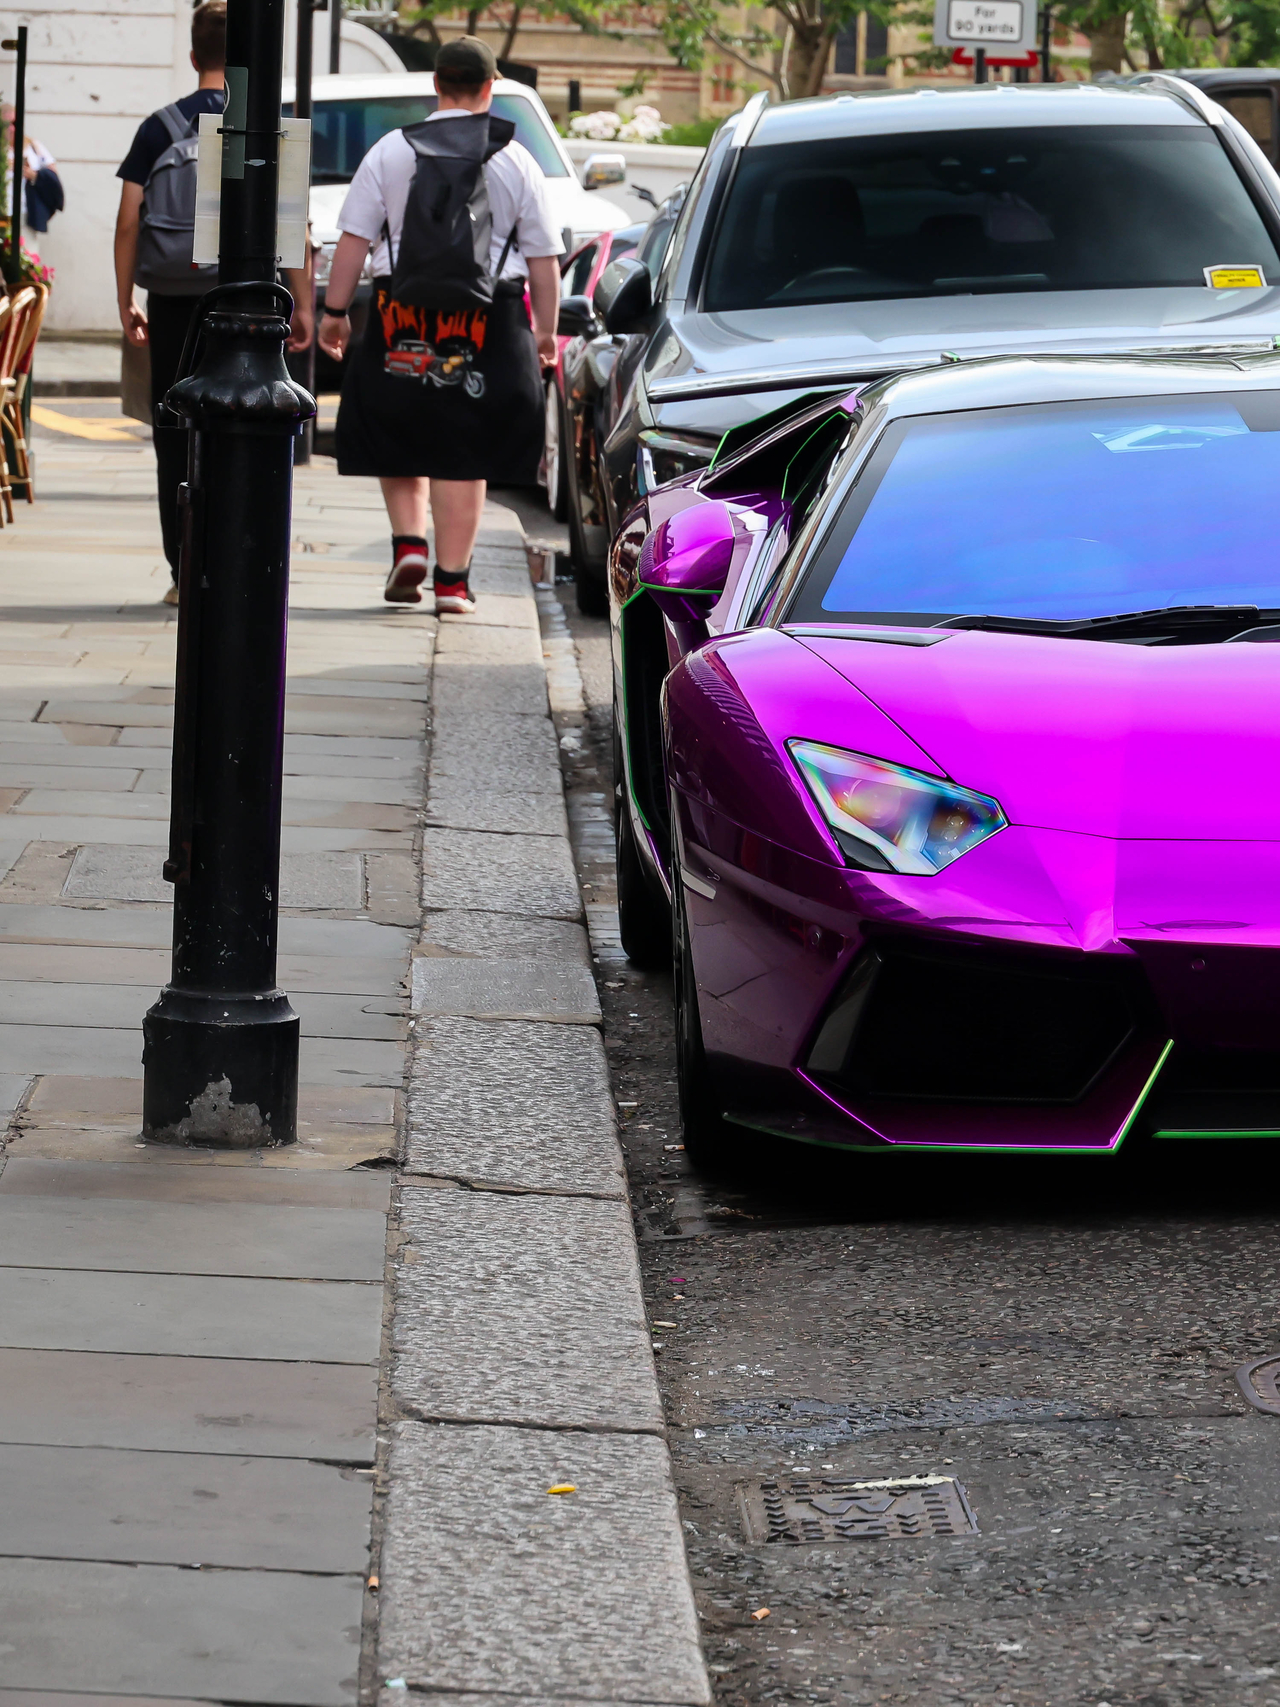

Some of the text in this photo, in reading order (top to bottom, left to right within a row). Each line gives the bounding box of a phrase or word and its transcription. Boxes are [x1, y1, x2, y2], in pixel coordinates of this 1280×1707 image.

[975, 6, 996, 18] For
[955, 20, 1015, 34] 90 yards
